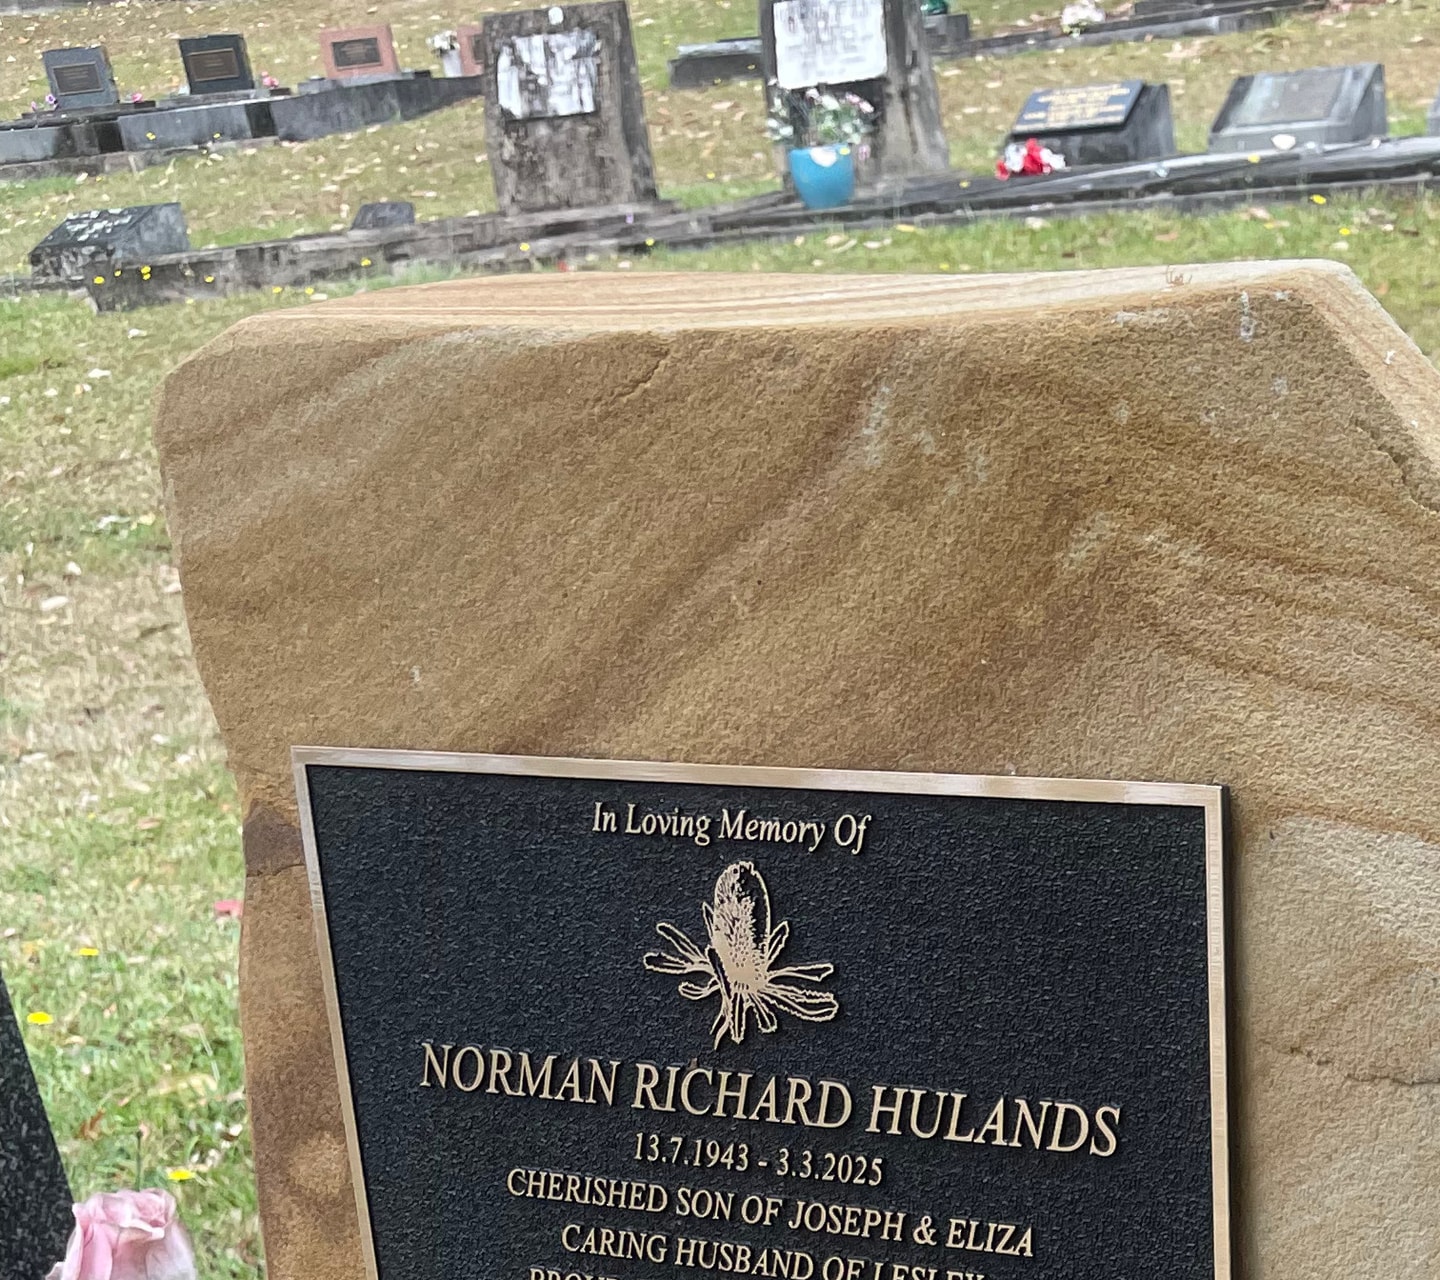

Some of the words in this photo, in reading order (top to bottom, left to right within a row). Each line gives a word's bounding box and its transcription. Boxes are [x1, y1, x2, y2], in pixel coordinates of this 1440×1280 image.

[592, 802, 618, 834] In
[624, 802, 712, 847] Loving
[717, 808, 826, 853] Memory
[832, 813, 873, 856] Of
[420, 1042, 620, 1106] NORMAN
[631, 1060, 853, 1129] RICHARD
[865, 1084, 1122, 1158] HULANDS
[634, 1131, 750, 1172] 13.7.1943
[775, 1148, 883, 1187] 3.3.2025
[506, 1167, 669, 1213] CHERISHED
[676, 1186, 736, 1222] SON
[740, 1194, 783, 1227] OF
[787, 1199, 907, 1243] JOSEPH
[911, 1214, 938, 1247] &
[944, 1217, 1034, 1258] ELIZA
[560, 1223, 668, 1264] CARING
